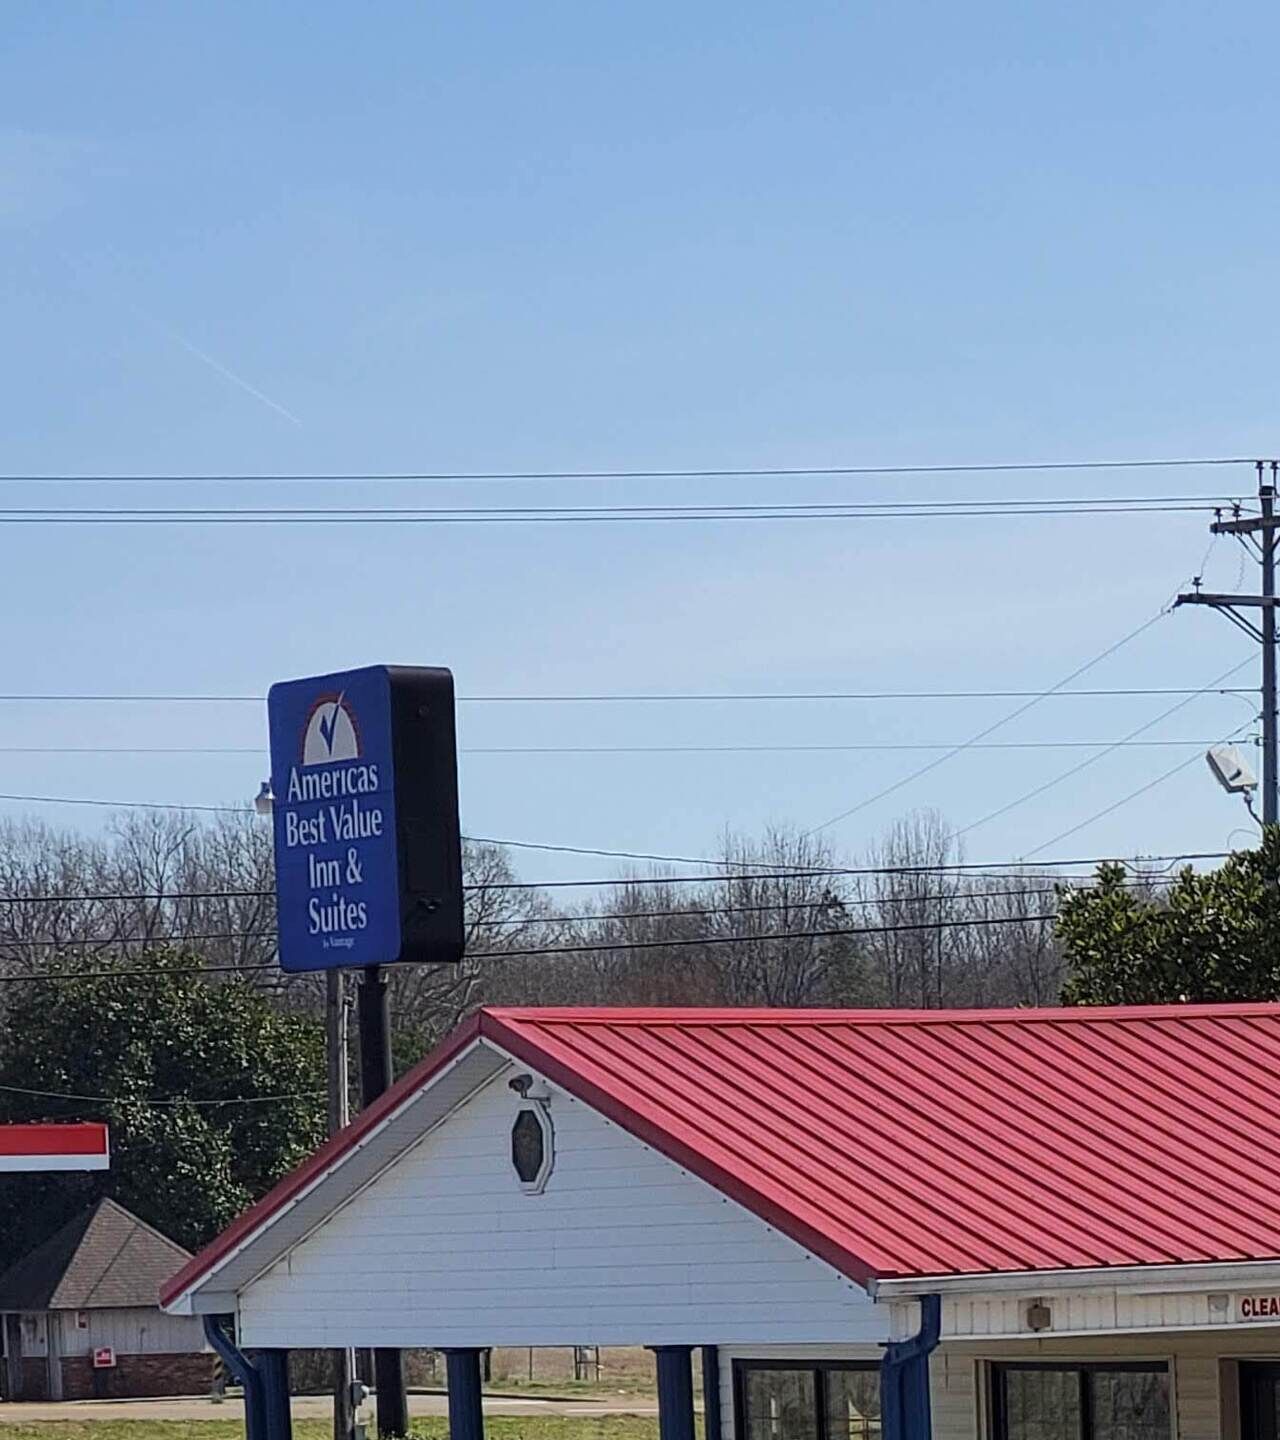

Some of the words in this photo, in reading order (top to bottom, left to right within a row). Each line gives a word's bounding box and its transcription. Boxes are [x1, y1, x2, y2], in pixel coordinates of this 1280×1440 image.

[288, 764, 378, 803] Americas
[286, 808, 327, 847] Best
[329, 799, 383, 841] Value
[309, 853, 340, 888] Inn
[346, 848, 362, 884] &
[309, 892, 367, 934] Suites
